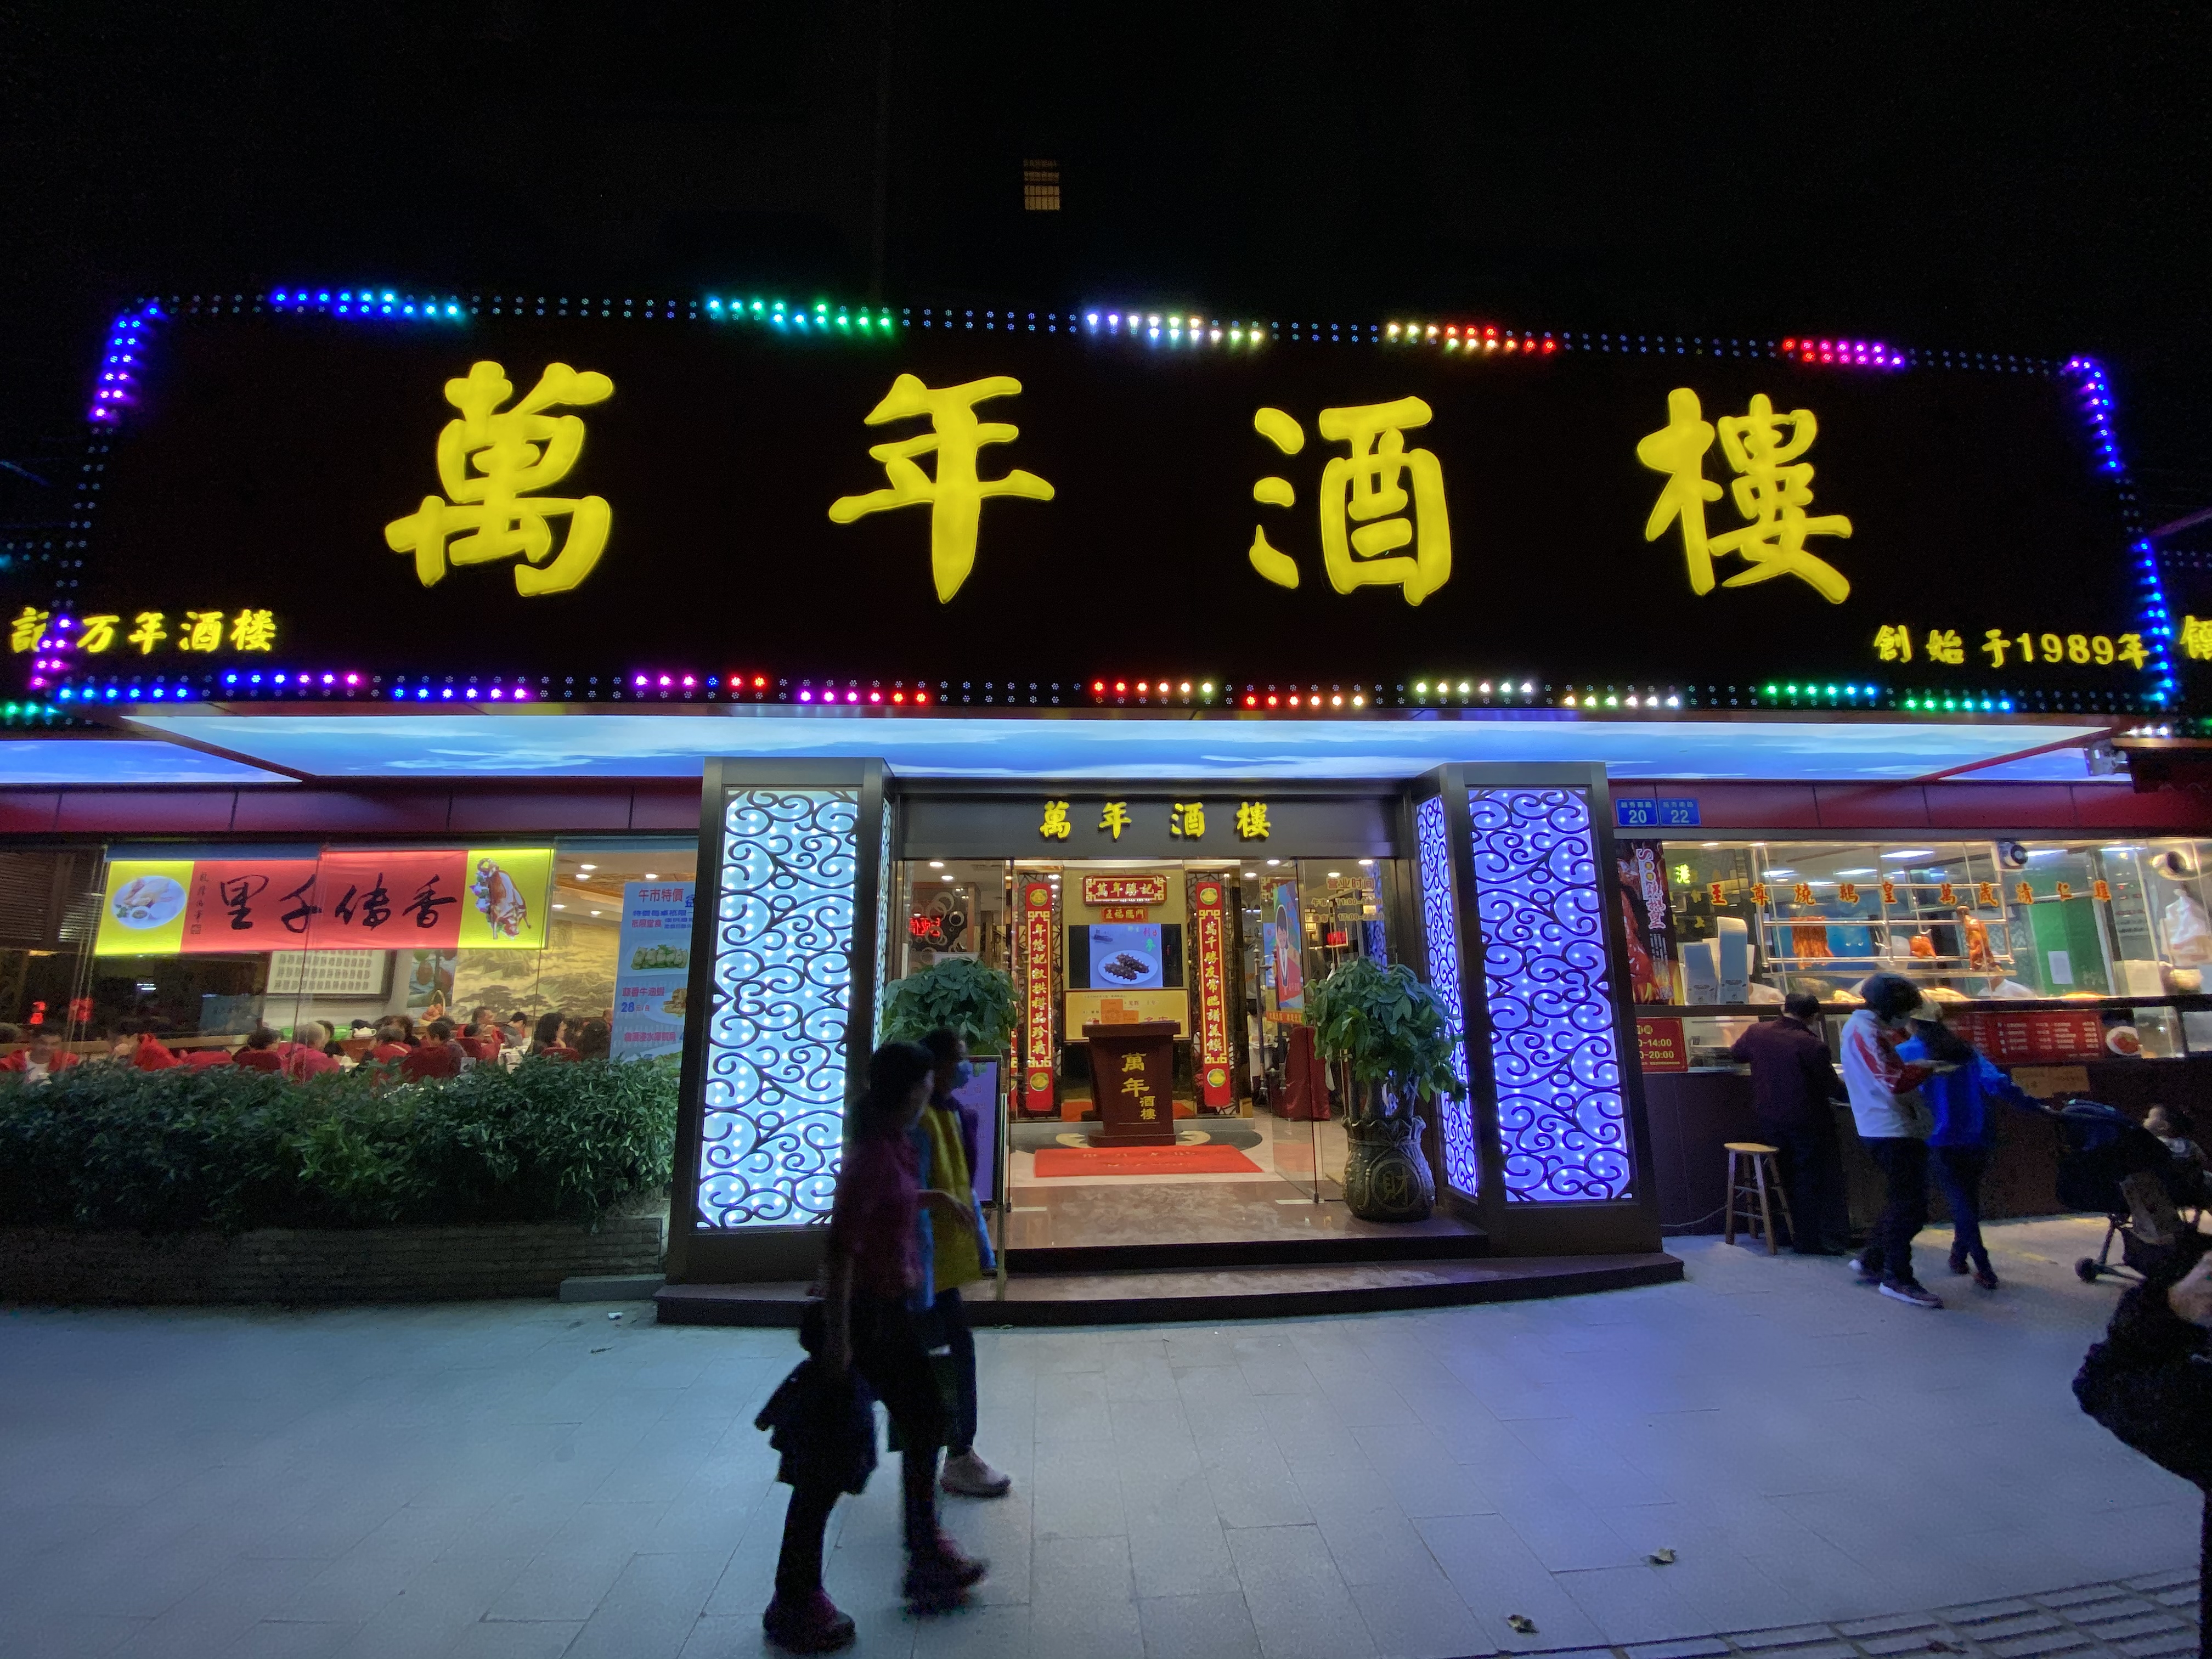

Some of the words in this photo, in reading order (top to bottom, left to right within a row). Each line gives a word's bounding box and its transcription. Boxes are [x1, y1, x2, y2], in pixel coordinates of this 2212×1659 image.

[385, 360, 1852, 606] 萬年酒樓
[77, 609, 275, 654] 万年酒楼
[1040, 801, 1271, 839] 萬年酒樓
[1629, 810, 1647, 823] 20
[1671, 810, 1689, 823] 22
[1096, 882, 1154, 897] 萬年勝記
[1328, 878, 1375, 889] 营业时间
[621, 1002, 635, 1012] 28
[1121, 1052, 1150, 1098] 萬年
[1139, 1096, 1156, 1120] 酒樓
